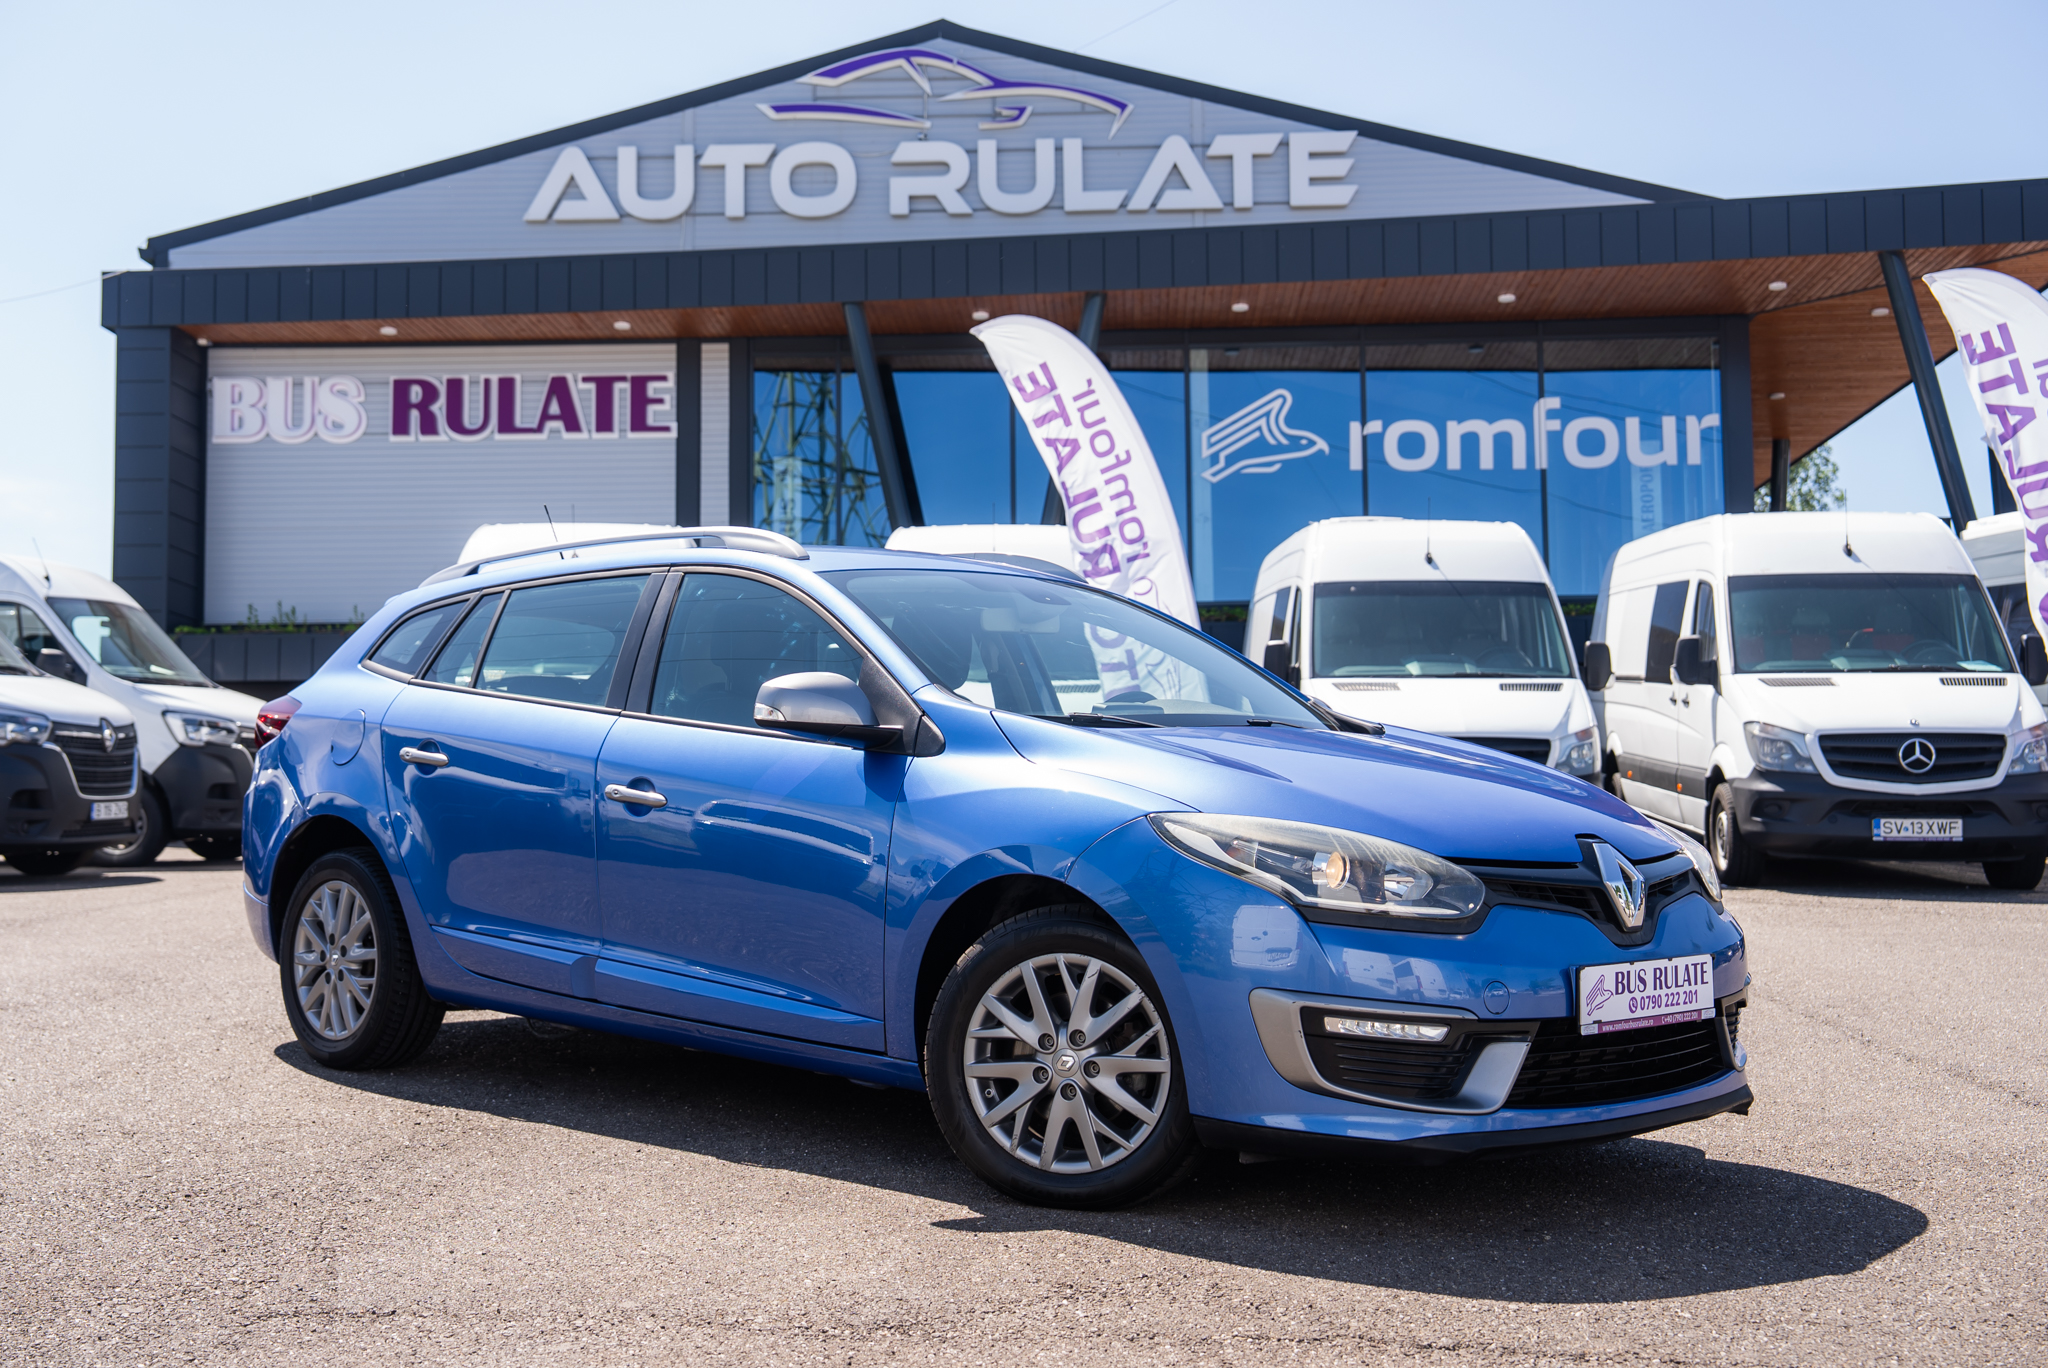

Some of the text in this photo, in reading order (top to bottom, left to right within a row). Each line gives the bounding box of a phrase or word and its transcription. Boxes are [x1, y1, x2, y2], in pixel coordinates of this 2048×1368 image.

[523, 130, 1359, 223] AUTO RULATE
[211, 371, 677, 445] BUS RULATE
[1349, 396, 1720, 471] romfour
[1615, 962, 1708, 995] BUS RULATE
[1640, 989, 1698, 1010] 0790 222 201
